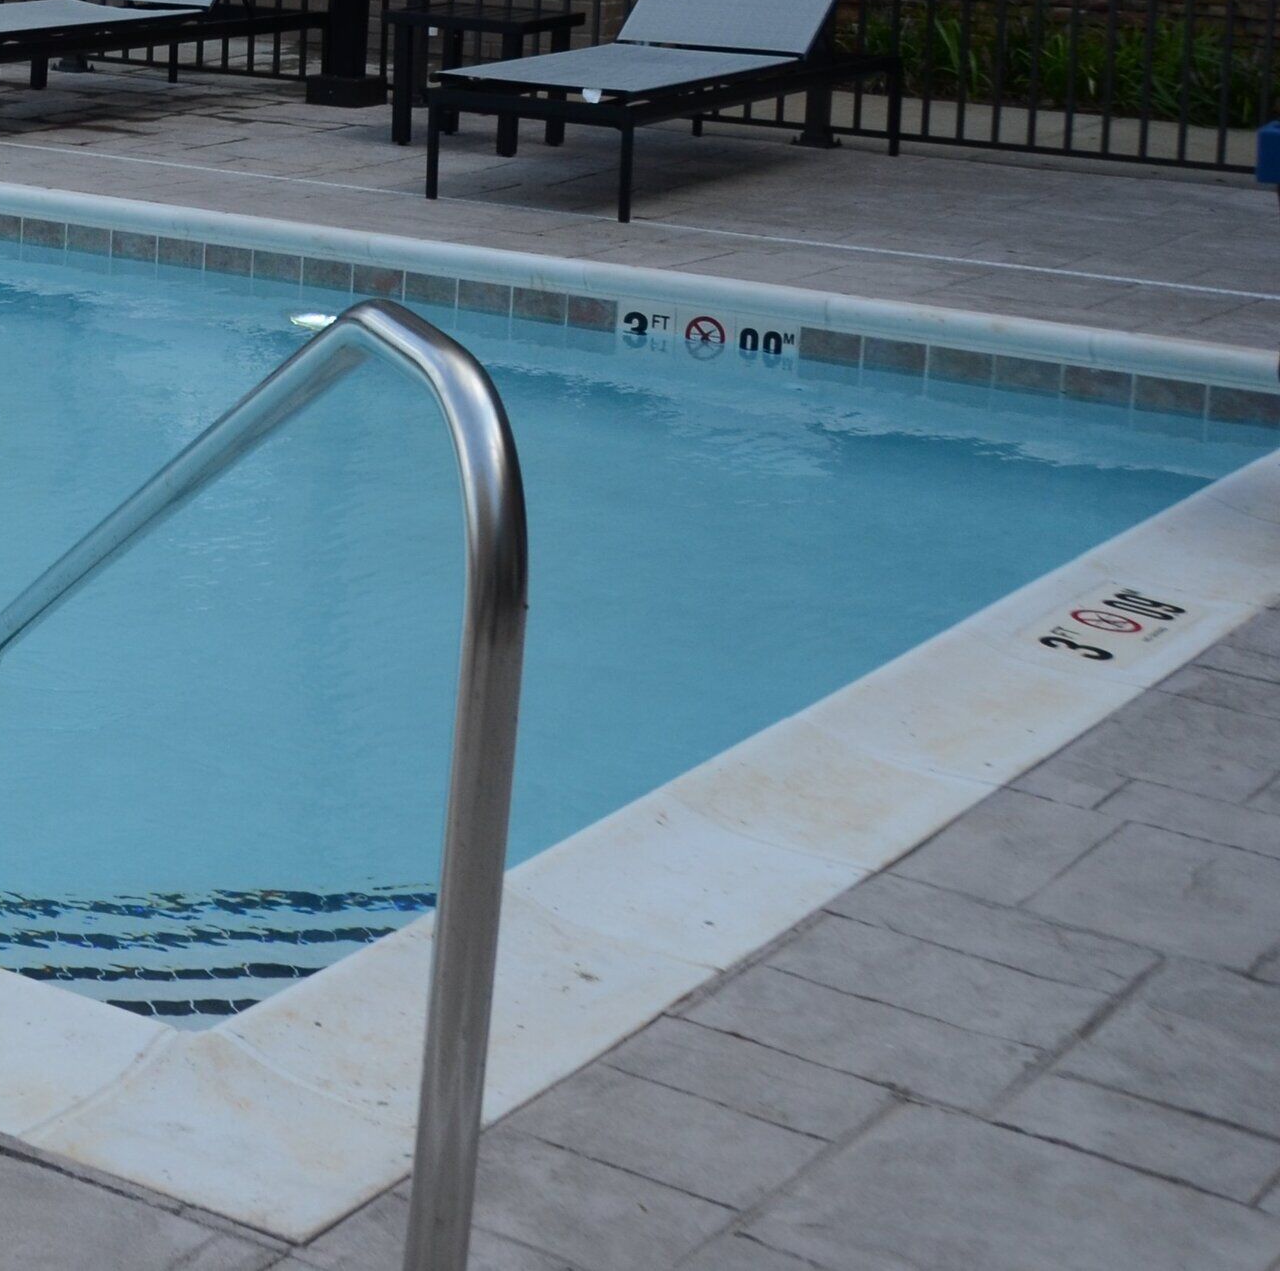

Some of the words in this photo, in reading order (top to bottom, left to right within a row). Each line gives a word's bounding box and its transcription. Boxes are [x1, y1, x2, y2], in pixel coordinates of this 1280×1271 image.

[652, 314, 670, 330] FT
[783, 332, 795, 346] M
[1039, 635, 1114, 661] 3
